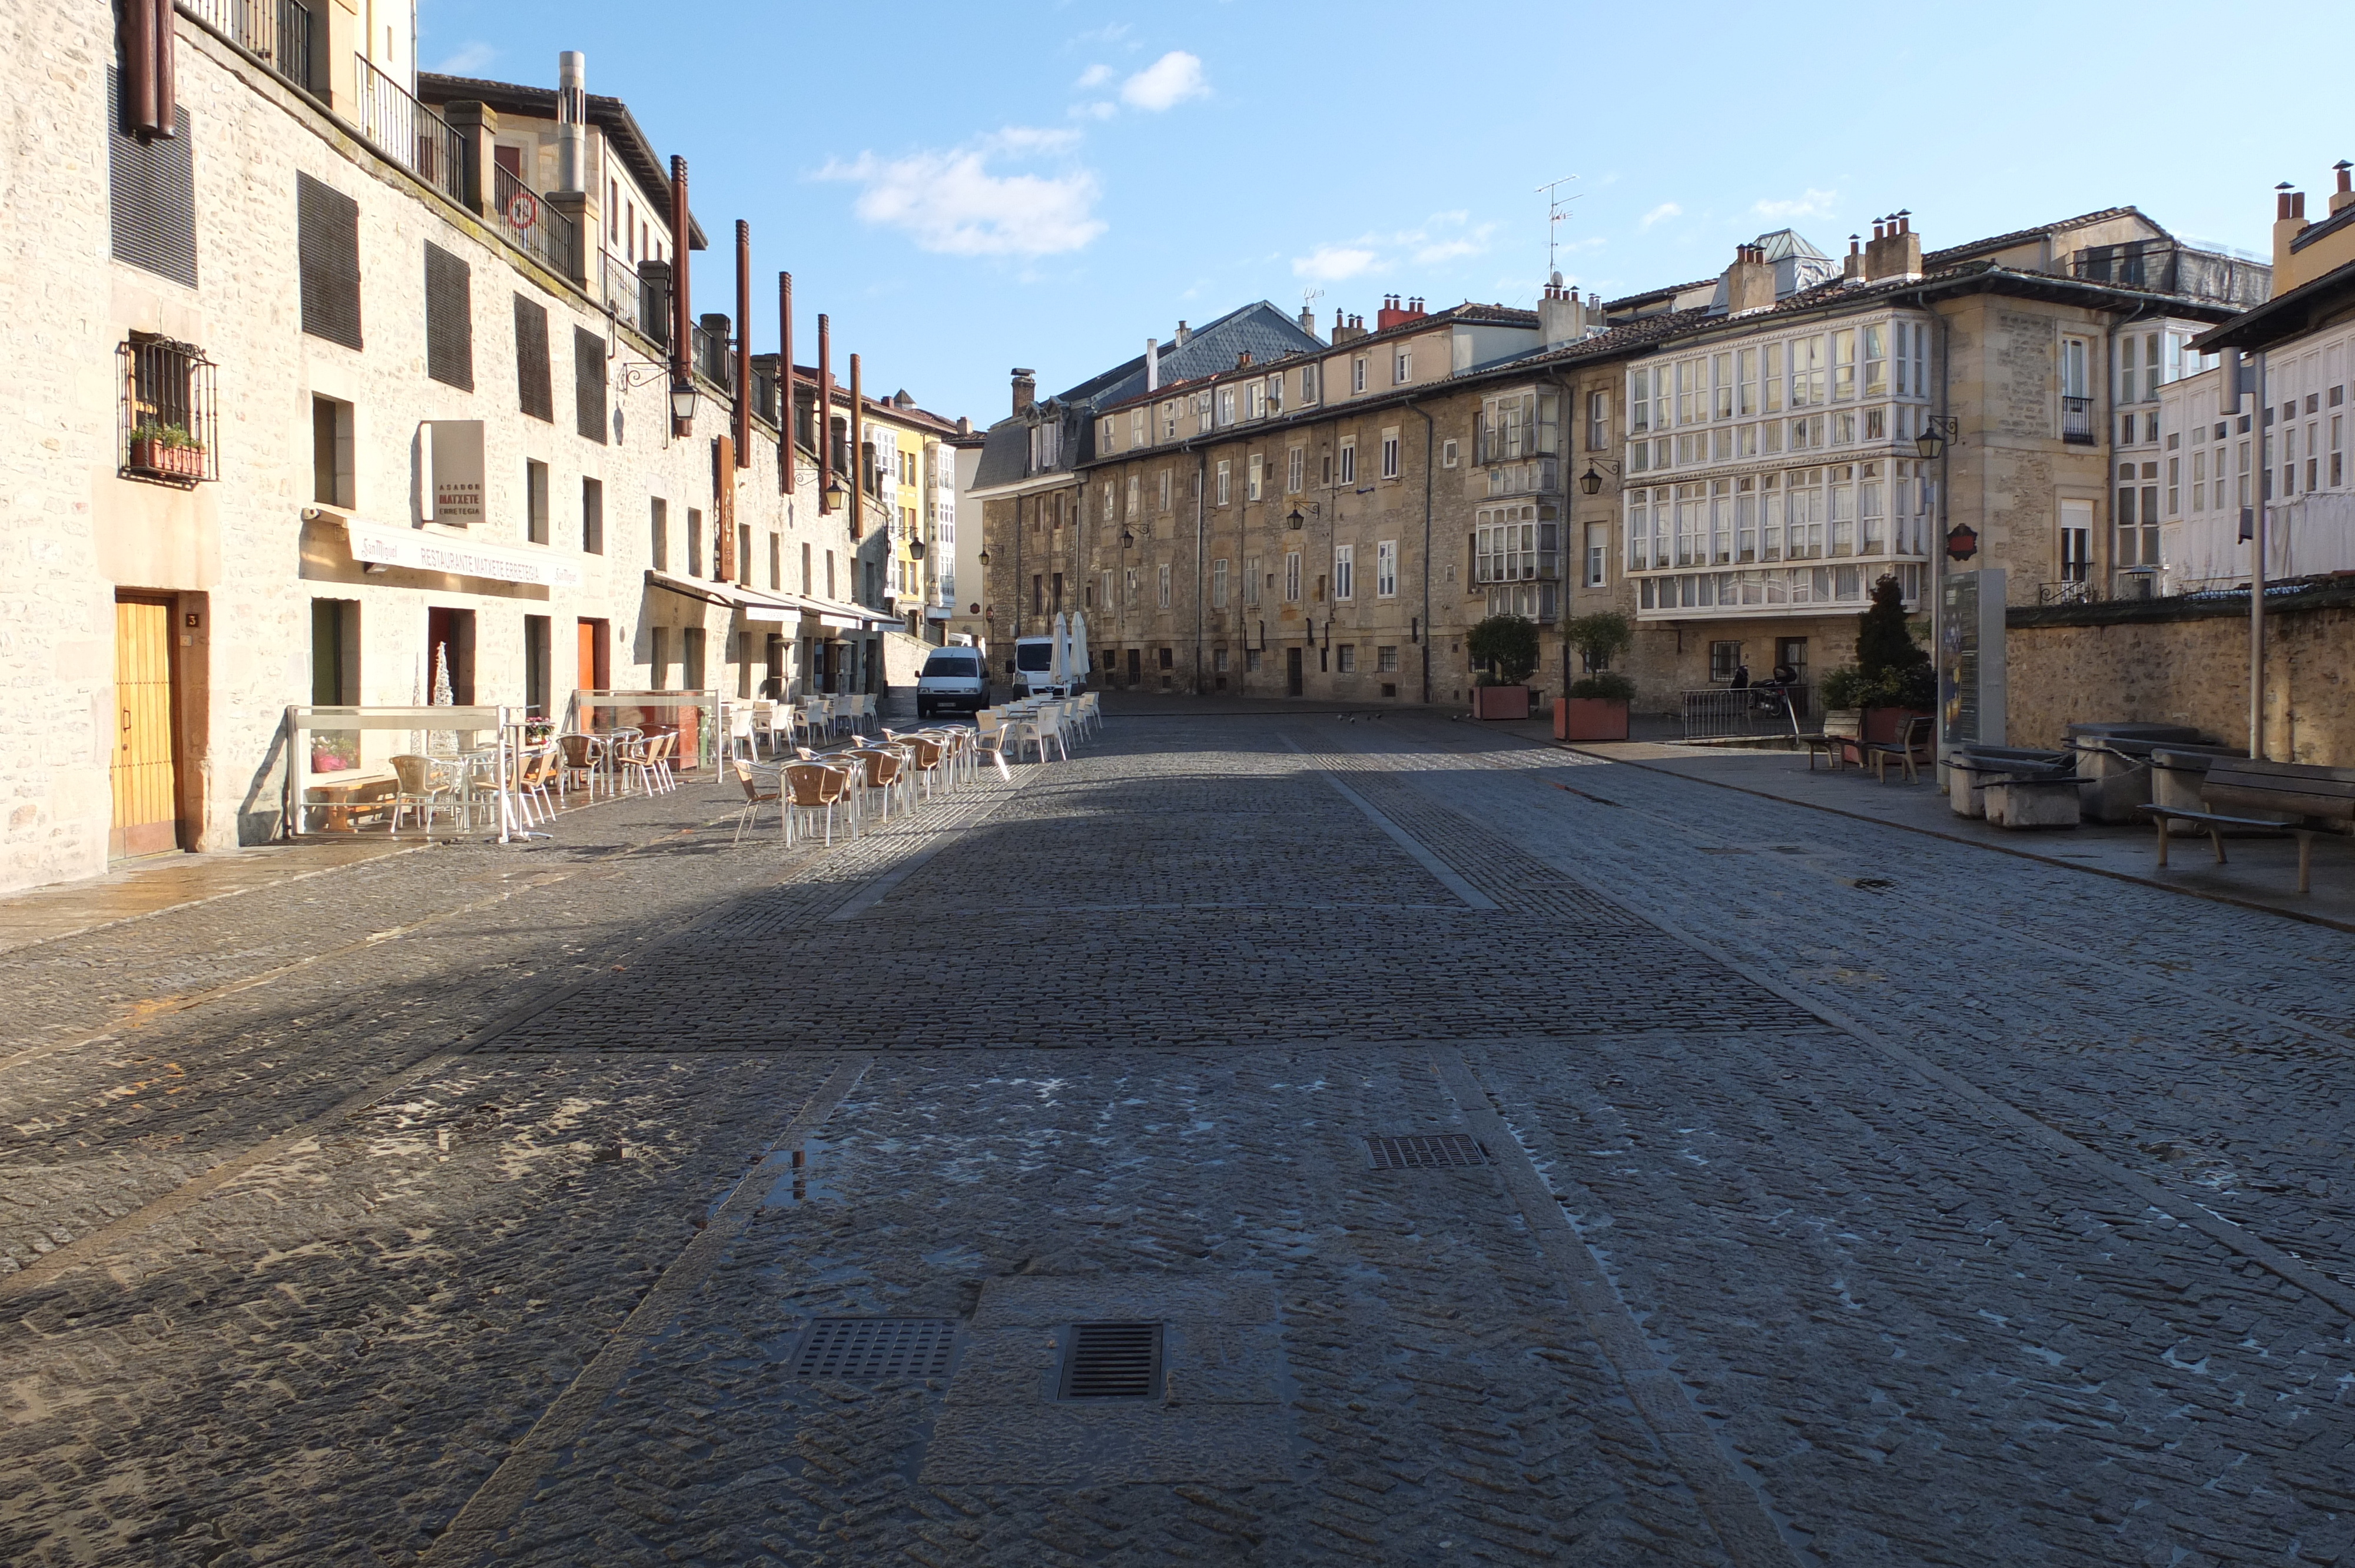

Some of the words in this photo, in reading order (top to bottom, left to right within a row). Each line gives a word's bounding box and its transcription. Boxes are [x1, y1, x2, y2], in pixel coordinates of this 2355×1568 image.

[439, 494, 479, 504] MATXETE
[420, 547, 473, 573] RESTAURANTE
[475, 557, 505, 577] MATXETE
[505, 562, 539, 582] ERRETEGIA
[189, 615, 195, 625] 3
